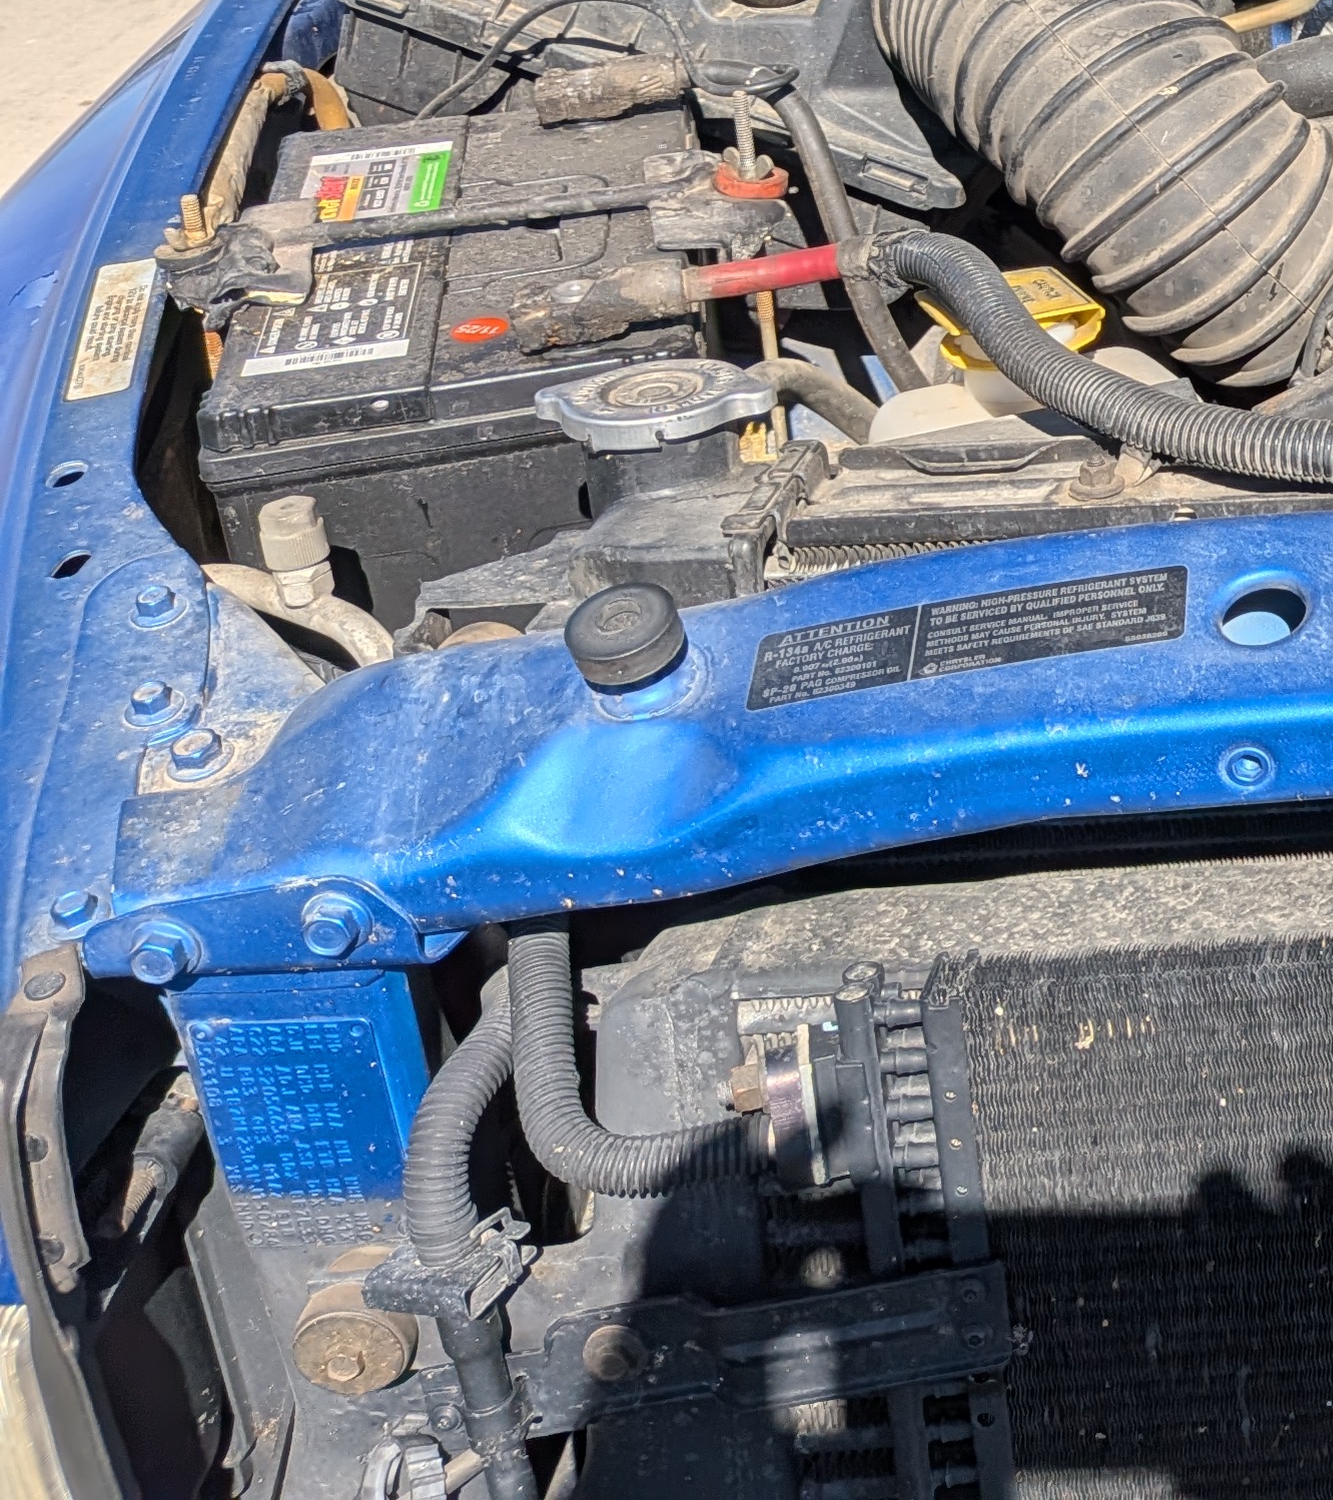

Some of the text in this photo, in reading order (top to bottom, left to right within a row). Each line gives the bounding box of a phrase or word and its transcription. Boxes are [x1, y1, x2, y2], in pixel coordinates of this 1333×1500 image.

[930, 583, 1164, 626] TO BE SERVICED BY QUALIFIED PERSONNEL ONLY.
[931, 573, 1168, 616] WARNING: HIGH-PRESSURE REFRIGERANT SYSTEM
[779, 615, 890, 646] ATTENTION
[926, 608, 1147, 647] METHODS MAY CAUSE PERSONAL INJURY. SYSTEM
[927, 600, 1139, 639] CONSULT SERVICE MANUAL. IMPROPER SERVICE
[813, 640, 832, 651] A/C
[835, 625, 911, 647] REFRIGERANT
[925, 645, 954, 656] MEETS
[956, 639, 989, 651] SAFETY
[991, 627, 1060, 645] REQUIREMENTS
[1062, 626, 1074, 634] OF
[1076, 622, 1093, 632] SAE
[1096, 616, 1143, 629] STANDARD
[776, 642, 873, 668] FACTORY CHARGE:
[939, 657, 1002, 672] CORPORATION
[940, 654, 985, 666] CHRYSLER
[791, 673, 814, 682] PART
[825, 669, 884, 685] COMPRESSOR
[887, 666, 901, 674] OIL
[769, 693, 792, 703] PART
